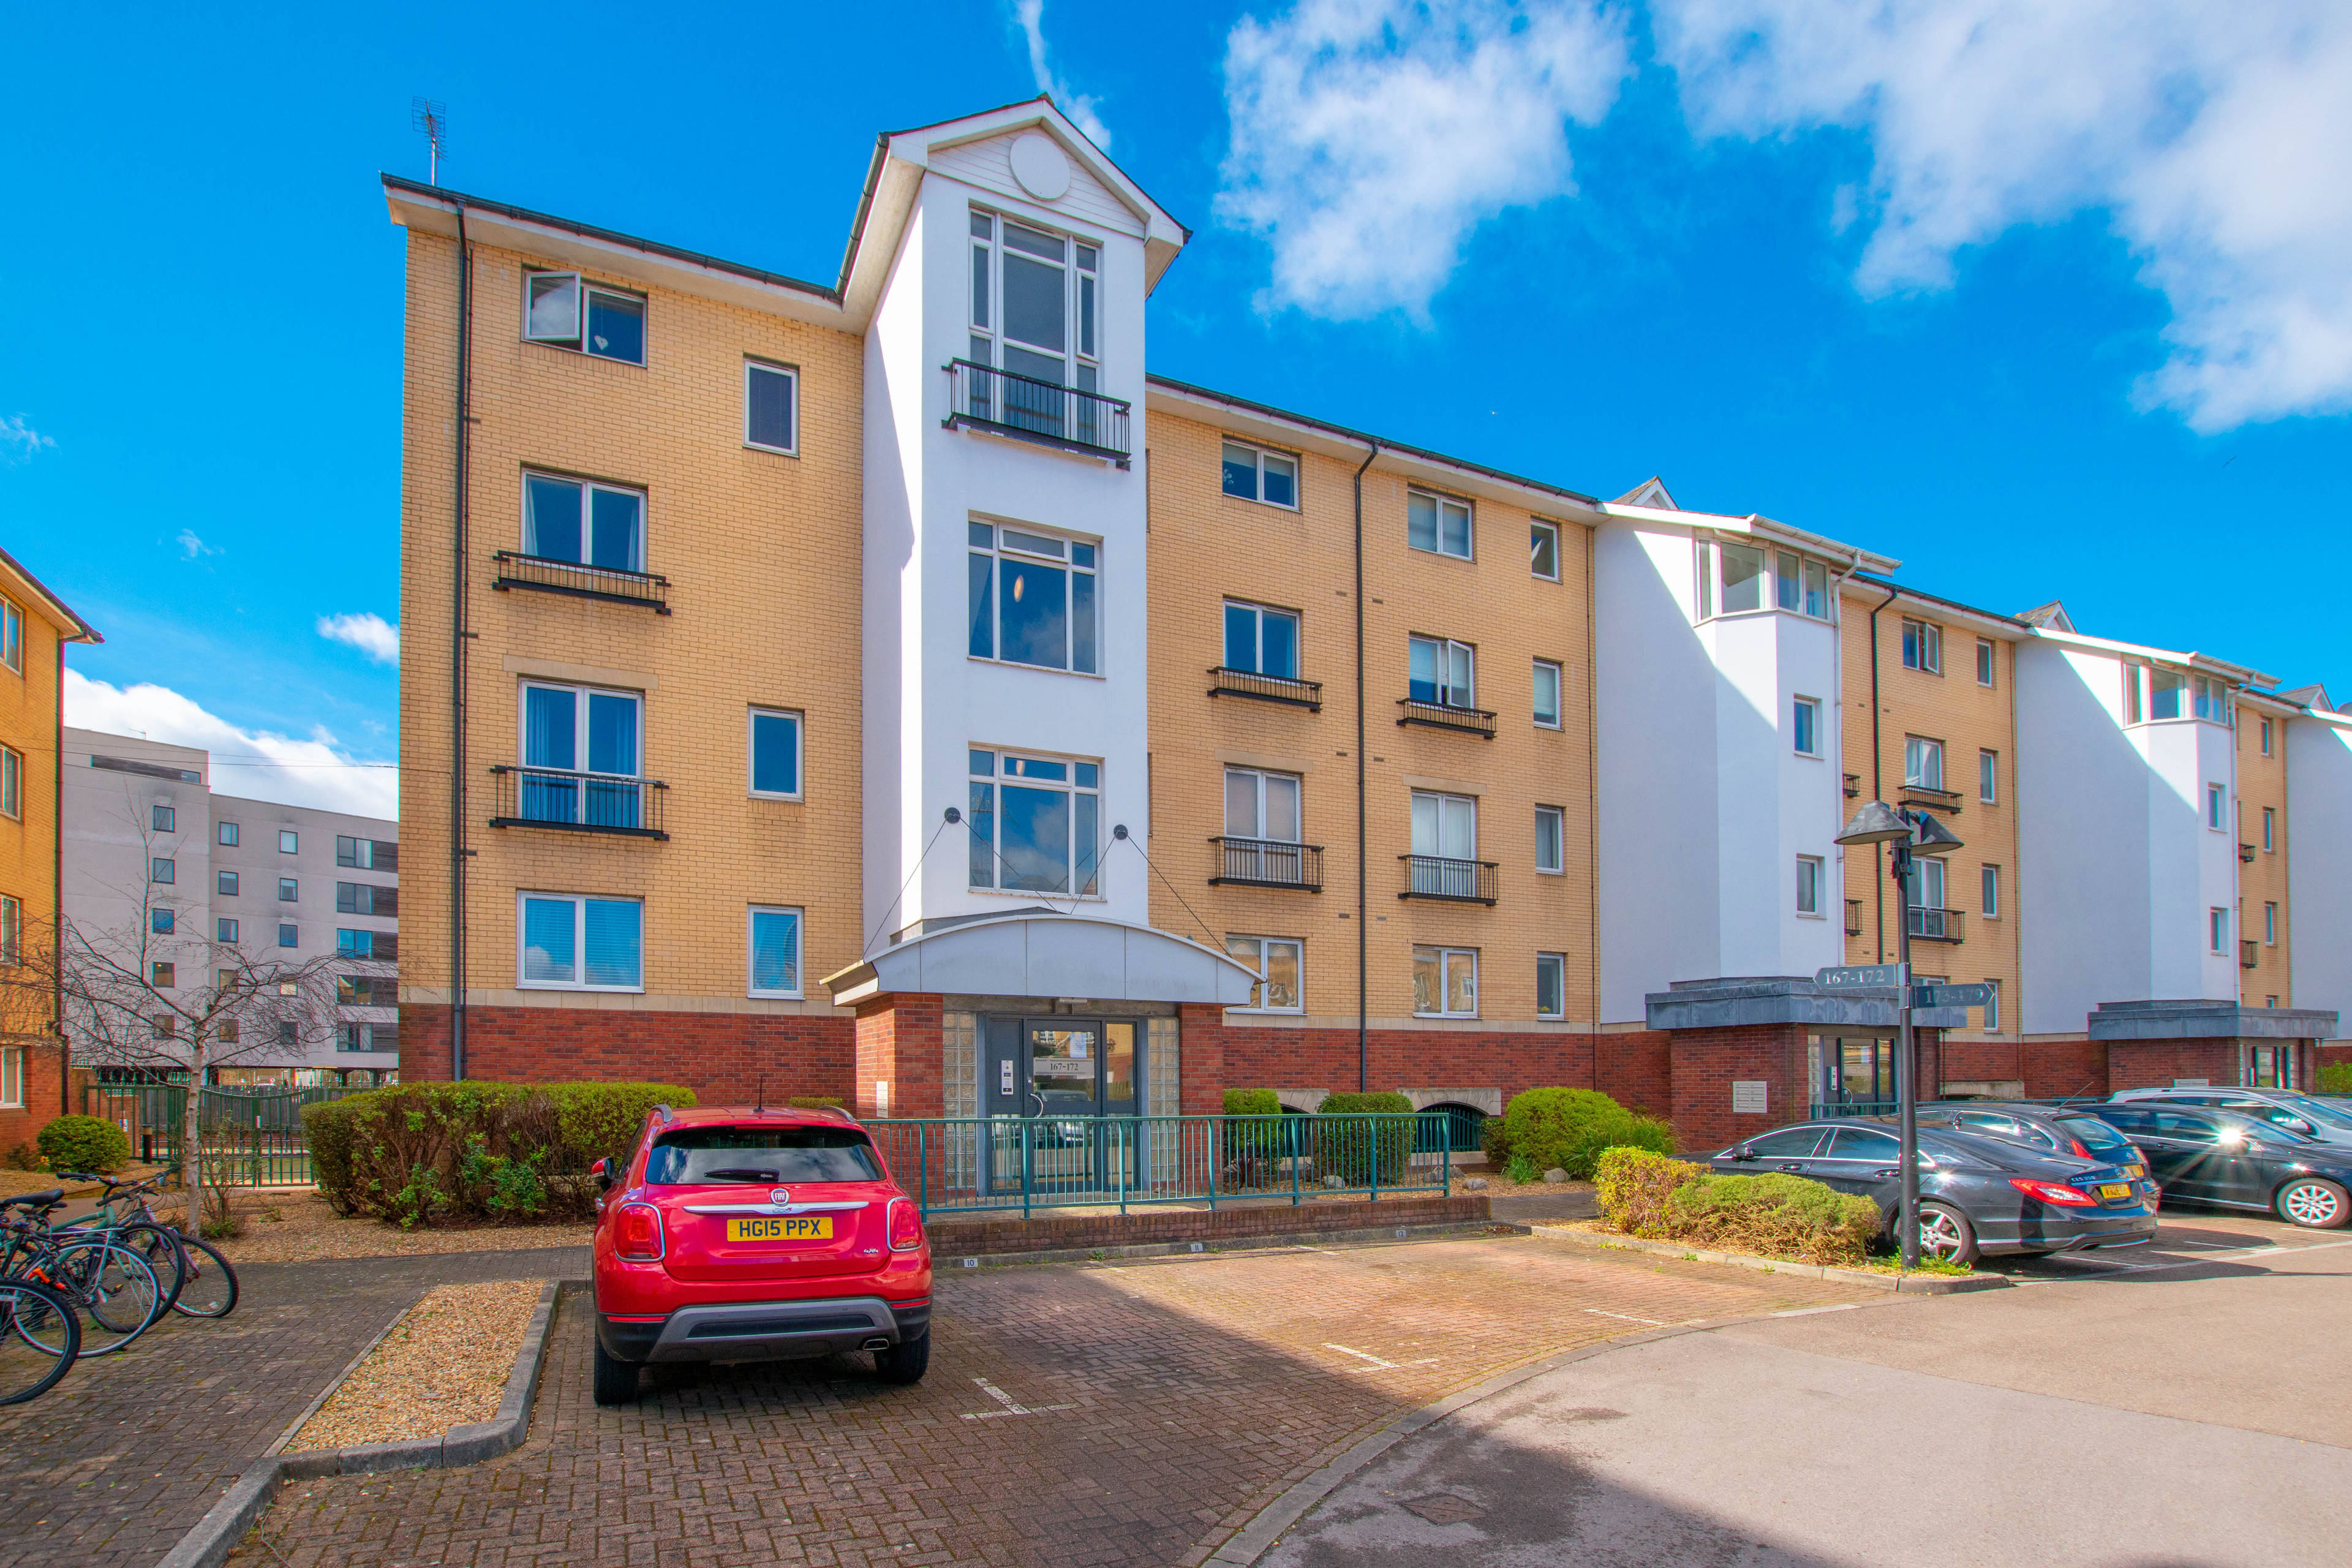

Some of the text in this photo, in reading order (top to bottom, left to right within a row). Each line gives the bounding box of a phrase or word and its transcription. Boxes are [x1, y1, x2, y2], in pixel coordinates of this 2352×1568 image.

[1825, 970, 1885, 984] 167-172
[739, 1219, 821, 1237] HG15 PPX
